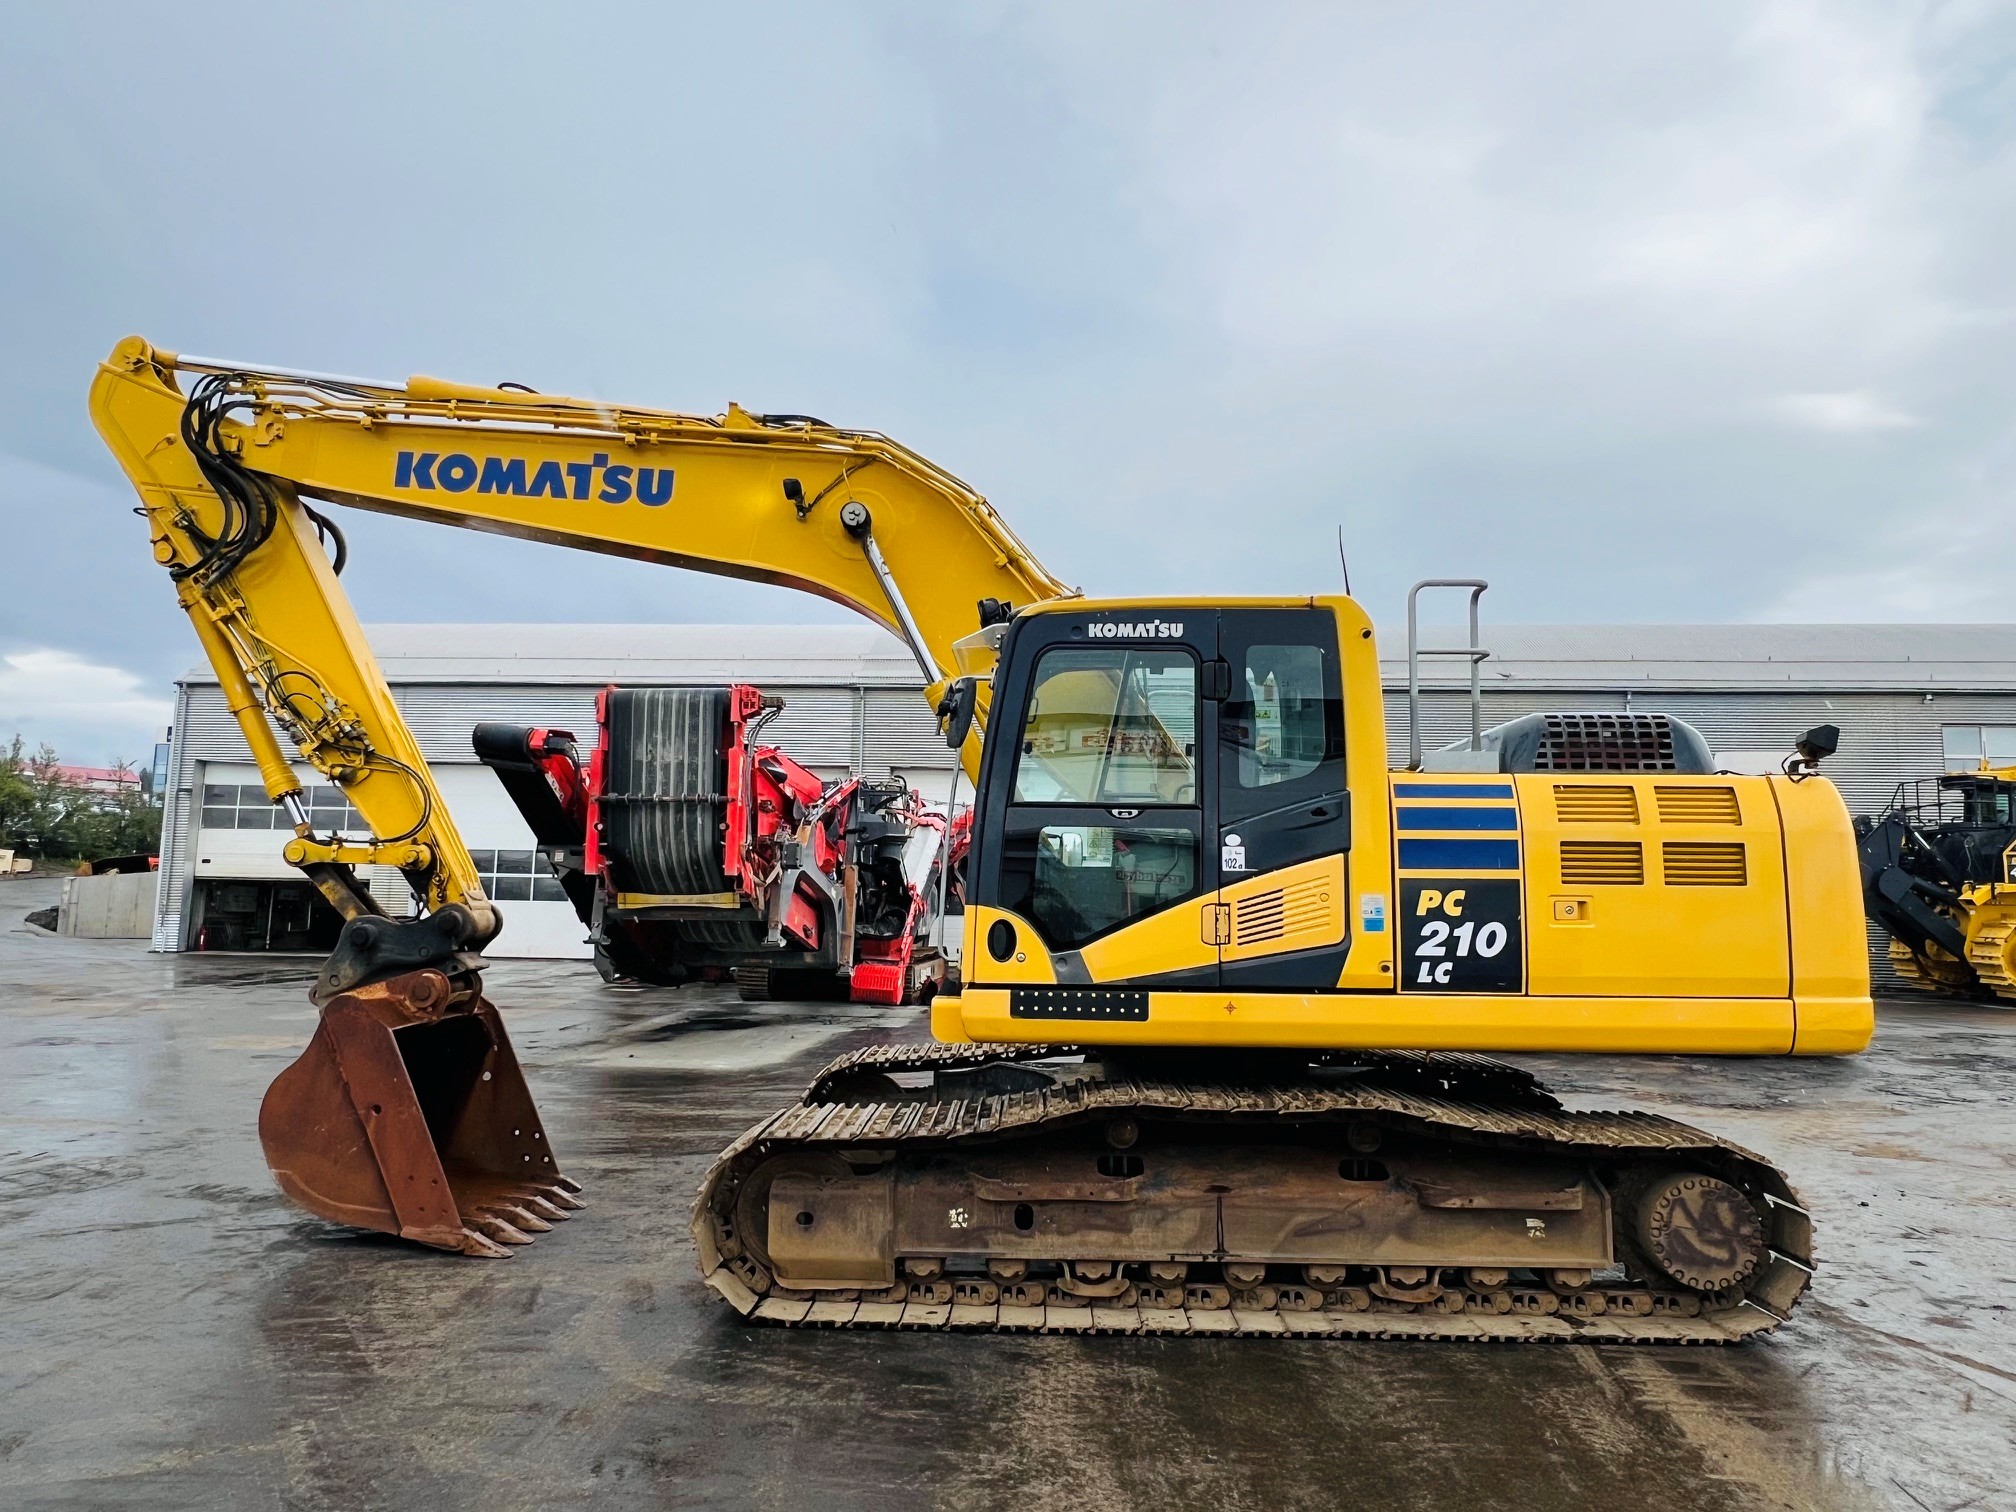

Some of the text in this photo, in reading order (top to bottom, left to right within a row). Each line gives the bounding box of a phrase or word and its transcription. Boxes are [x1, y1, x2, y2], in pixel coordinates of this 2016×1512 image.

[394, 451, 675, 507] KOMATSU
[1088, 619, 1184, 638] KOMATSU
[1224, 857, 1238, 869] 102
[1416, 889, 1466, 917] PC
[1414, 920, 1508, 958] 210
[1417, 961, 1454, 984] LC
